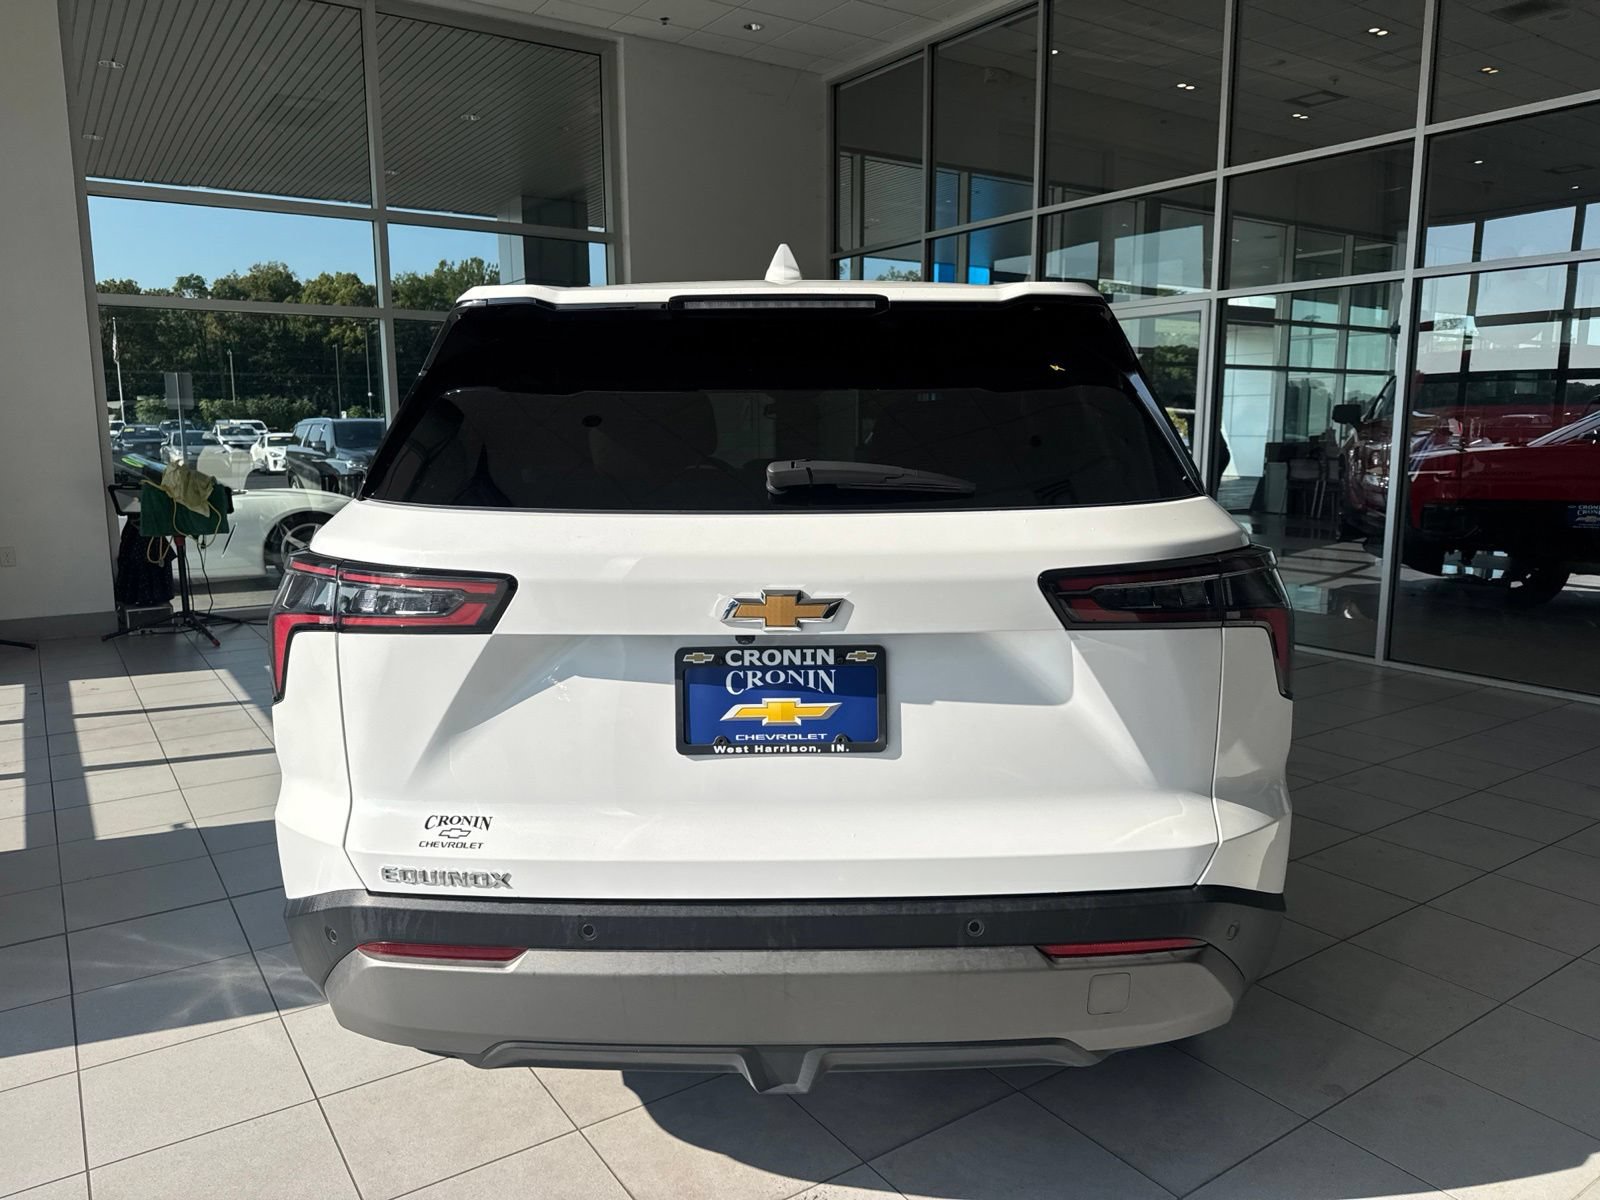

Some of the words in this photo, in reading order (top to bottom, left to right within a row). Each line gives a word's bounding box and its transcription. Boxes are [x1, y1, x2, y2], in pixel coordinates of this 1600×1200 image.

[725, 649, 835, 666] CRONIN
[725, 669, 836, 695] CRONIN
[735, 733, 828, 741] CHEVROLET
[713, 745, 749, 754] West
[754, 744, 821, 754] Harrison,
[831, 743, 850, 752] IN.
[424, 814, 493, 831] CRONIN
[418, 840, 484, 849] CHEVROLET
[381, 866, 513, 889] EQUINOX
